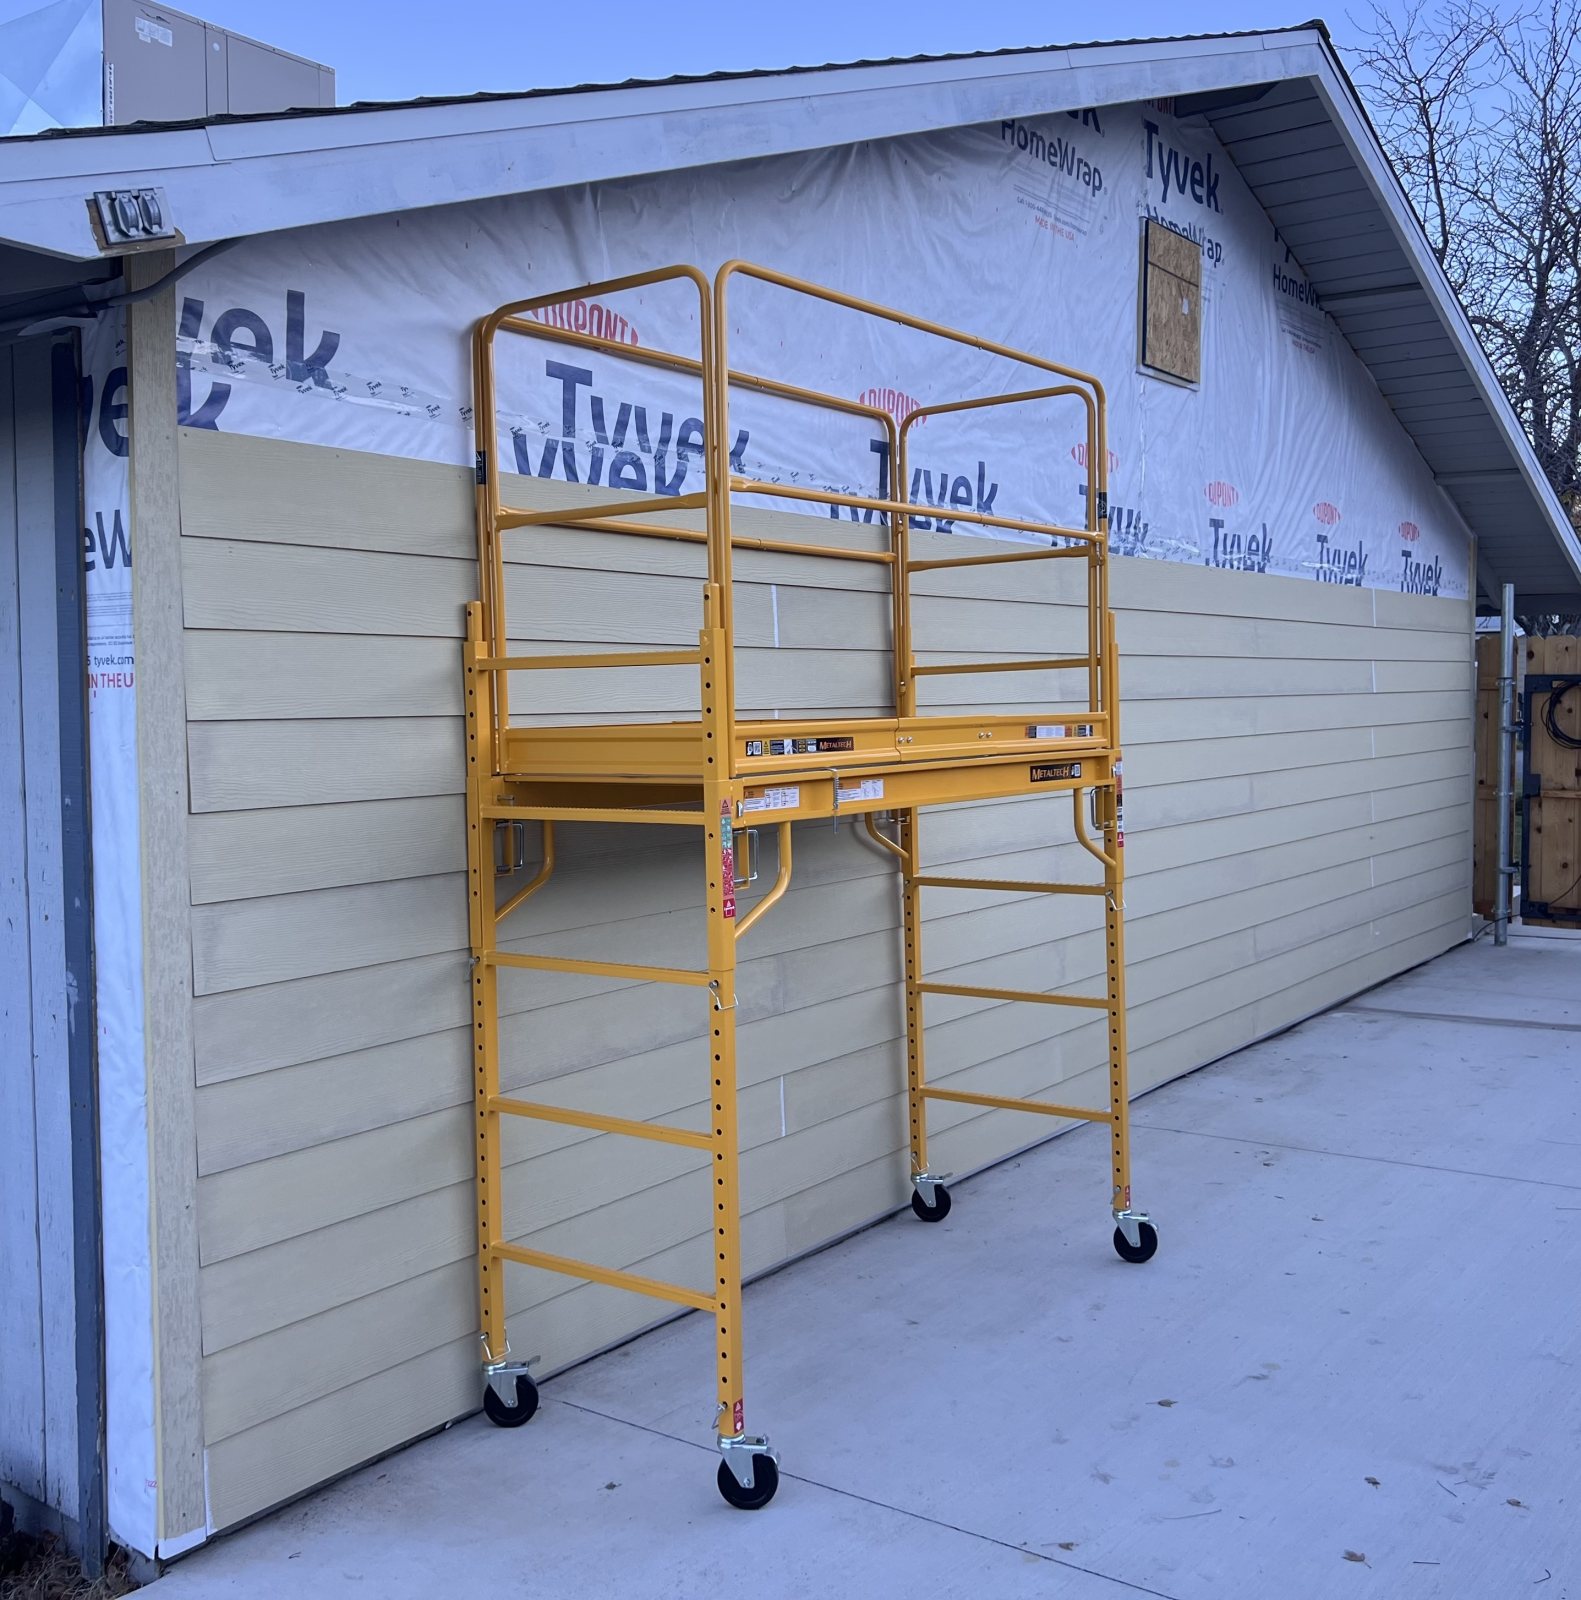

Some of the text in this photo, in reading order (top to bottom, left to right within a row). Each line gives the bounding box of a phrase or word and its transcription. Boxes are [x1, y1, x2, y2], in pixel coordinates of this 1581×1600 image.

[1001, 118, 1103, 197] HomeWrap
[1144, 117, 1220, 213] Tyvek
[1273, 263, 1320, 309] HomeW
[100, 673, 122, 688] THE
[1032, 766, 1070, 780] METALTECH
